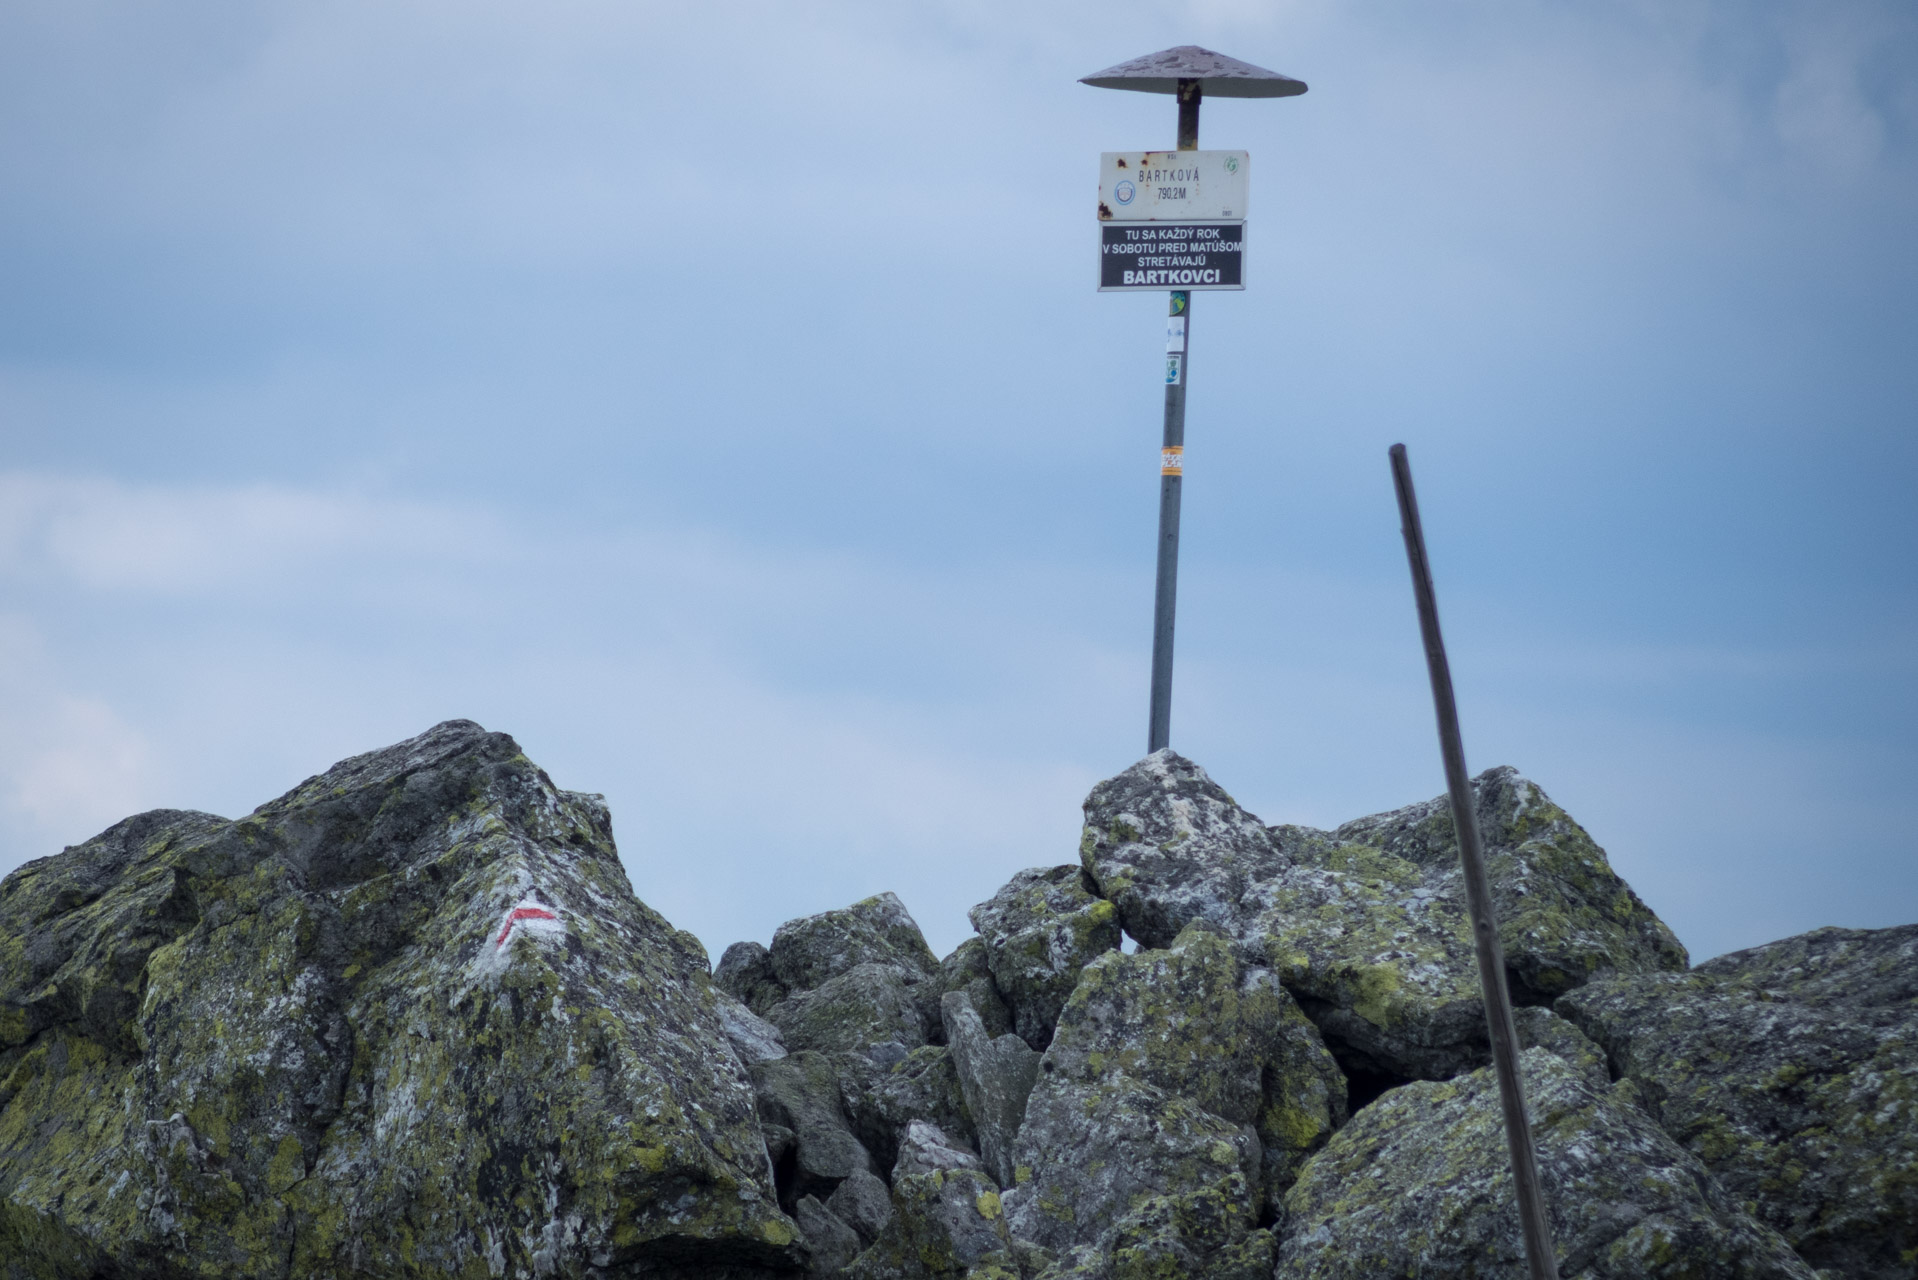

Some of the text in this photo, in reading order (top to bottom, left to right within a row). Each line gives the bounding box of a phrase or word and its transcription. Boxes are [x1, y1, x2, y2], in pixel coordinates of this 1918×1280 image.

[1139, 167, 1199, 182] BARTKOVÁ
[1126, 227, 1220, 240] TU SA KAŽDÝ ROK
[1102, 240, 1242, 254] V SOBOTU PRED MATÚŠOM
[1138, 253, 1206, 267] STRETÁVAJÚ
[1123, 269, 1220, 284] BARTKOVCI
